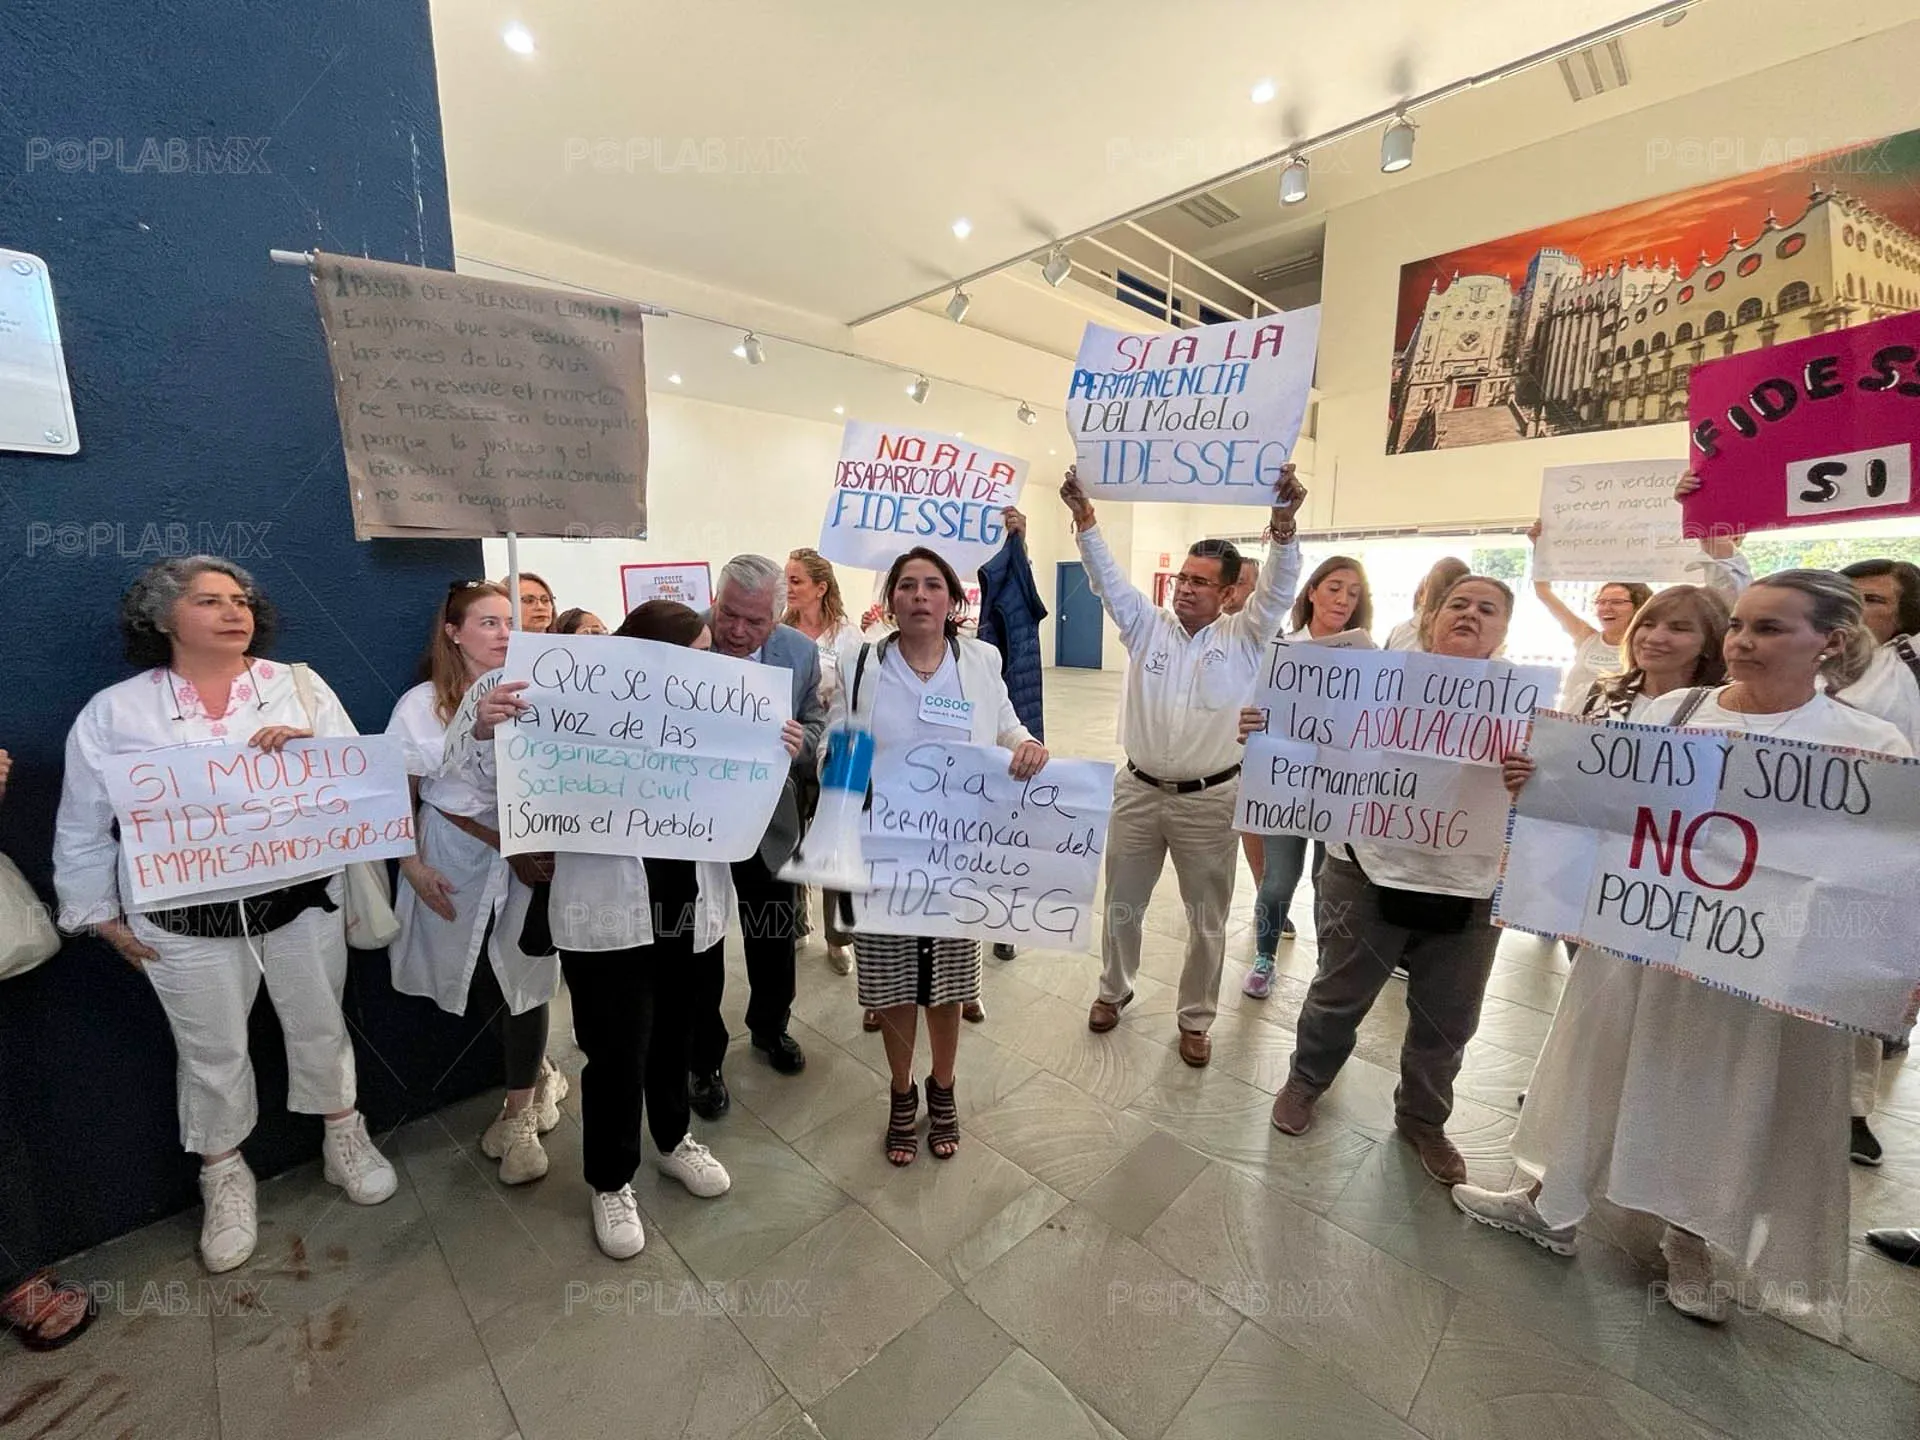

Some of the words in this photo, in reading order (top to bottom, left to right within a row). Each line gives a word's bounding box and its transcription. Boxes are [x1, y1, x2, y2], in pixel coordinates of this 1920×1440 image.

[1167, 336, 1199, 365] A
[1224, 324, 1285, 361] LA
[1068, 362, 1250, 401] PERMANENCIA
[1691, 345, 1920, 458] FIDES
[876, 433, 927, 463] NO
[931, 443, 961, 467] A
[964, 452, 1016, 485] LA
[1799, 458, 1888, 504] SI
[831, 488, 1006, 546] FIDESSEG
[532, 647, 606, 694] Que
[611, 667, 651, 701] se
[663, 674, 771, 723] escuche
[924, 695, 971, 712] COSOC
[1267, 641, 1361, 701] Tomen
[1374, 666, 1405, 703] en
[1423, 668, 1539, 715] cuenta
[550, 707, 596, 737] voz
[608, 712, 645, 741] de
[658, 714, 697, 749] las
[1289, 702, 1335, 746] las
[128, 763, 182, 803] SI
[207, 744, 368, 795] MODELO
[507, 735, 699, 778] Organizaciones
[708, 758, 740, 781] de
[749, 758, 769, 782] la
[1577, 732, 1697, 787] SOLAS
[1716, 744, 1733, 791] Y
[1743, 746, 1873, 816] SOLOS
[516, 768, 625, 799] Sociedad
[637, 779, 694, 801] Civil
[963, 773, 995, 803] a
[1021, 776, 1077, 820] la
[129, 783, 350, 845] FIDESSEG
[506, 802, 581, 840] ¡Somos
[590, 809, 614, 834] el
[625, 807, 714, 843] Pueblo!
[1245, 799, 1332, 833] modelo
[1347, 800, 1470, 850] FIDESSEG
[1055, 827, 1101, 858] del
[1628, 805, 1760, 891] NO
[864, 858, 1080, 943] FIDESSEG
[1596, 871, 1767, 960] PODEMOS
